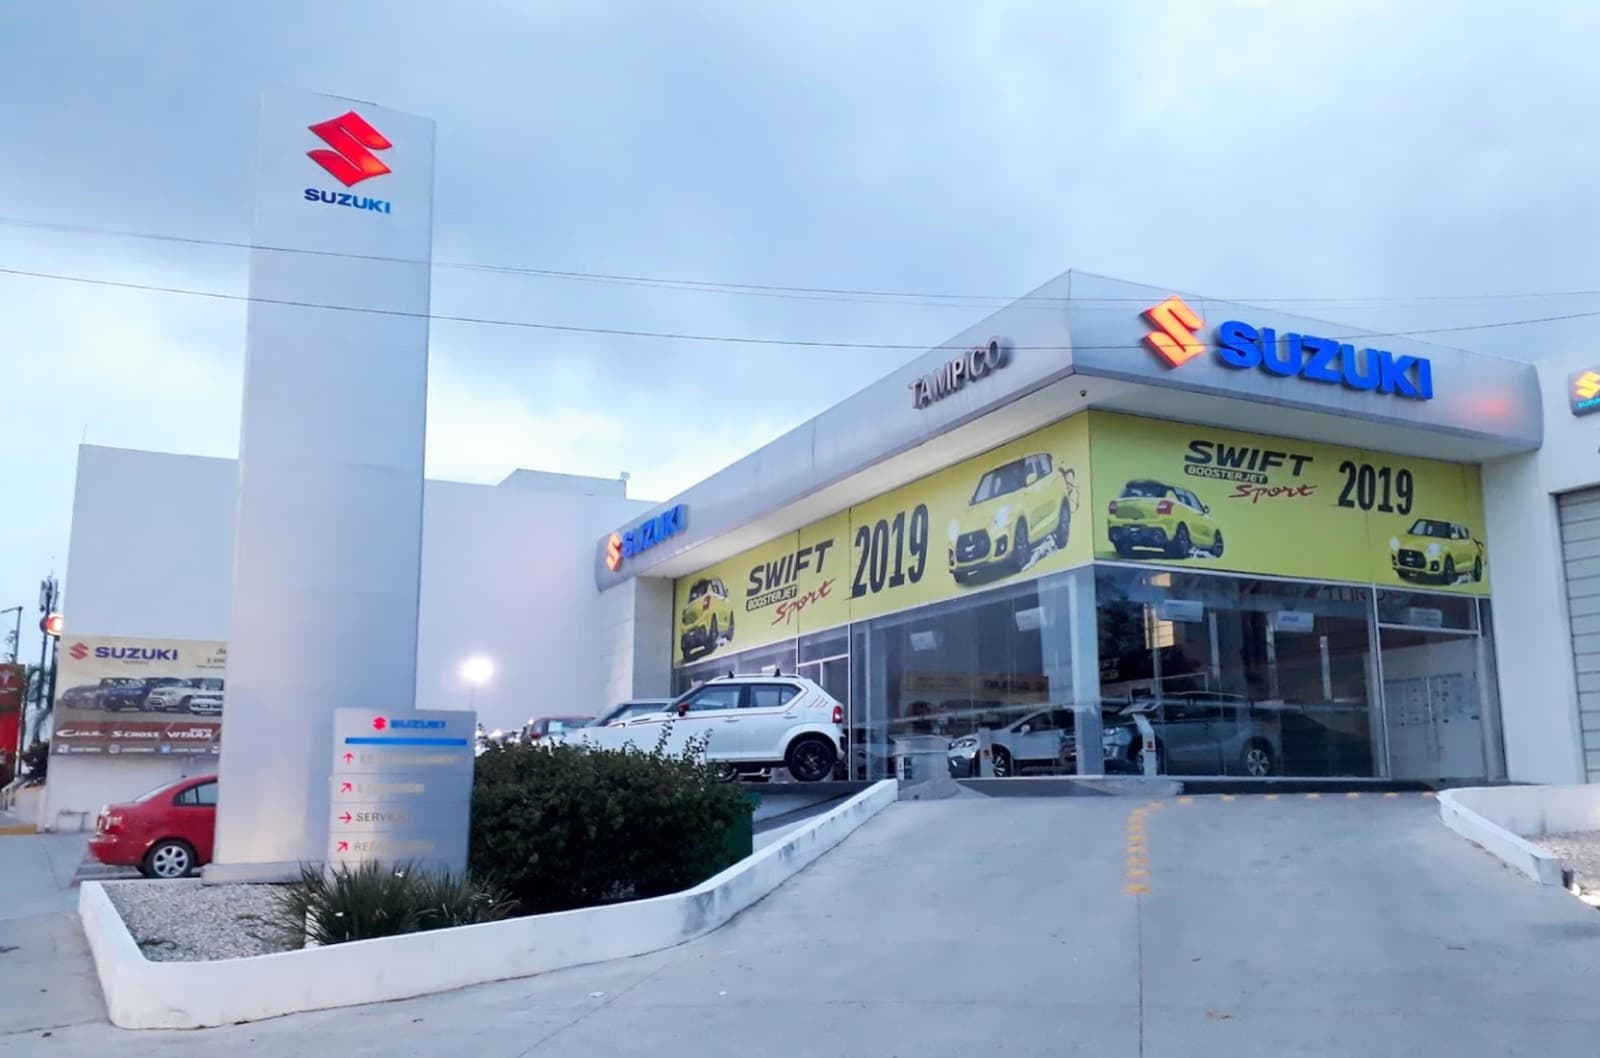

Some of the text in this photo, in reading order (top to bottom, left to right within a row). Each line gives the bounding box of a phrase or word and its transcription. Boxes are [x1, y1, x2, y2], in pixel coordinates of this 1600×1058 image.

[304, 188, 391, 214] SUZUKI
[908, 336, 1008, 410] TAMPICO
[1215, 320, 1433, 401] SUZUKI
[1184, 440, 1314, 477] SWIFT
[1187, 465, 1266, 483] BOOSTERJET
[1228, 484, 1318, 504] Sport
[1338, 460, 1414, 516] 2019
[623, 503, 688, 558] SUZUKI
[852, 503, 929, 598] 2019
[746, 538, 834, 597] SWIFT
[771, 577, 837, 626] Sport
[94, 646, 179, 661] SUZUKI
